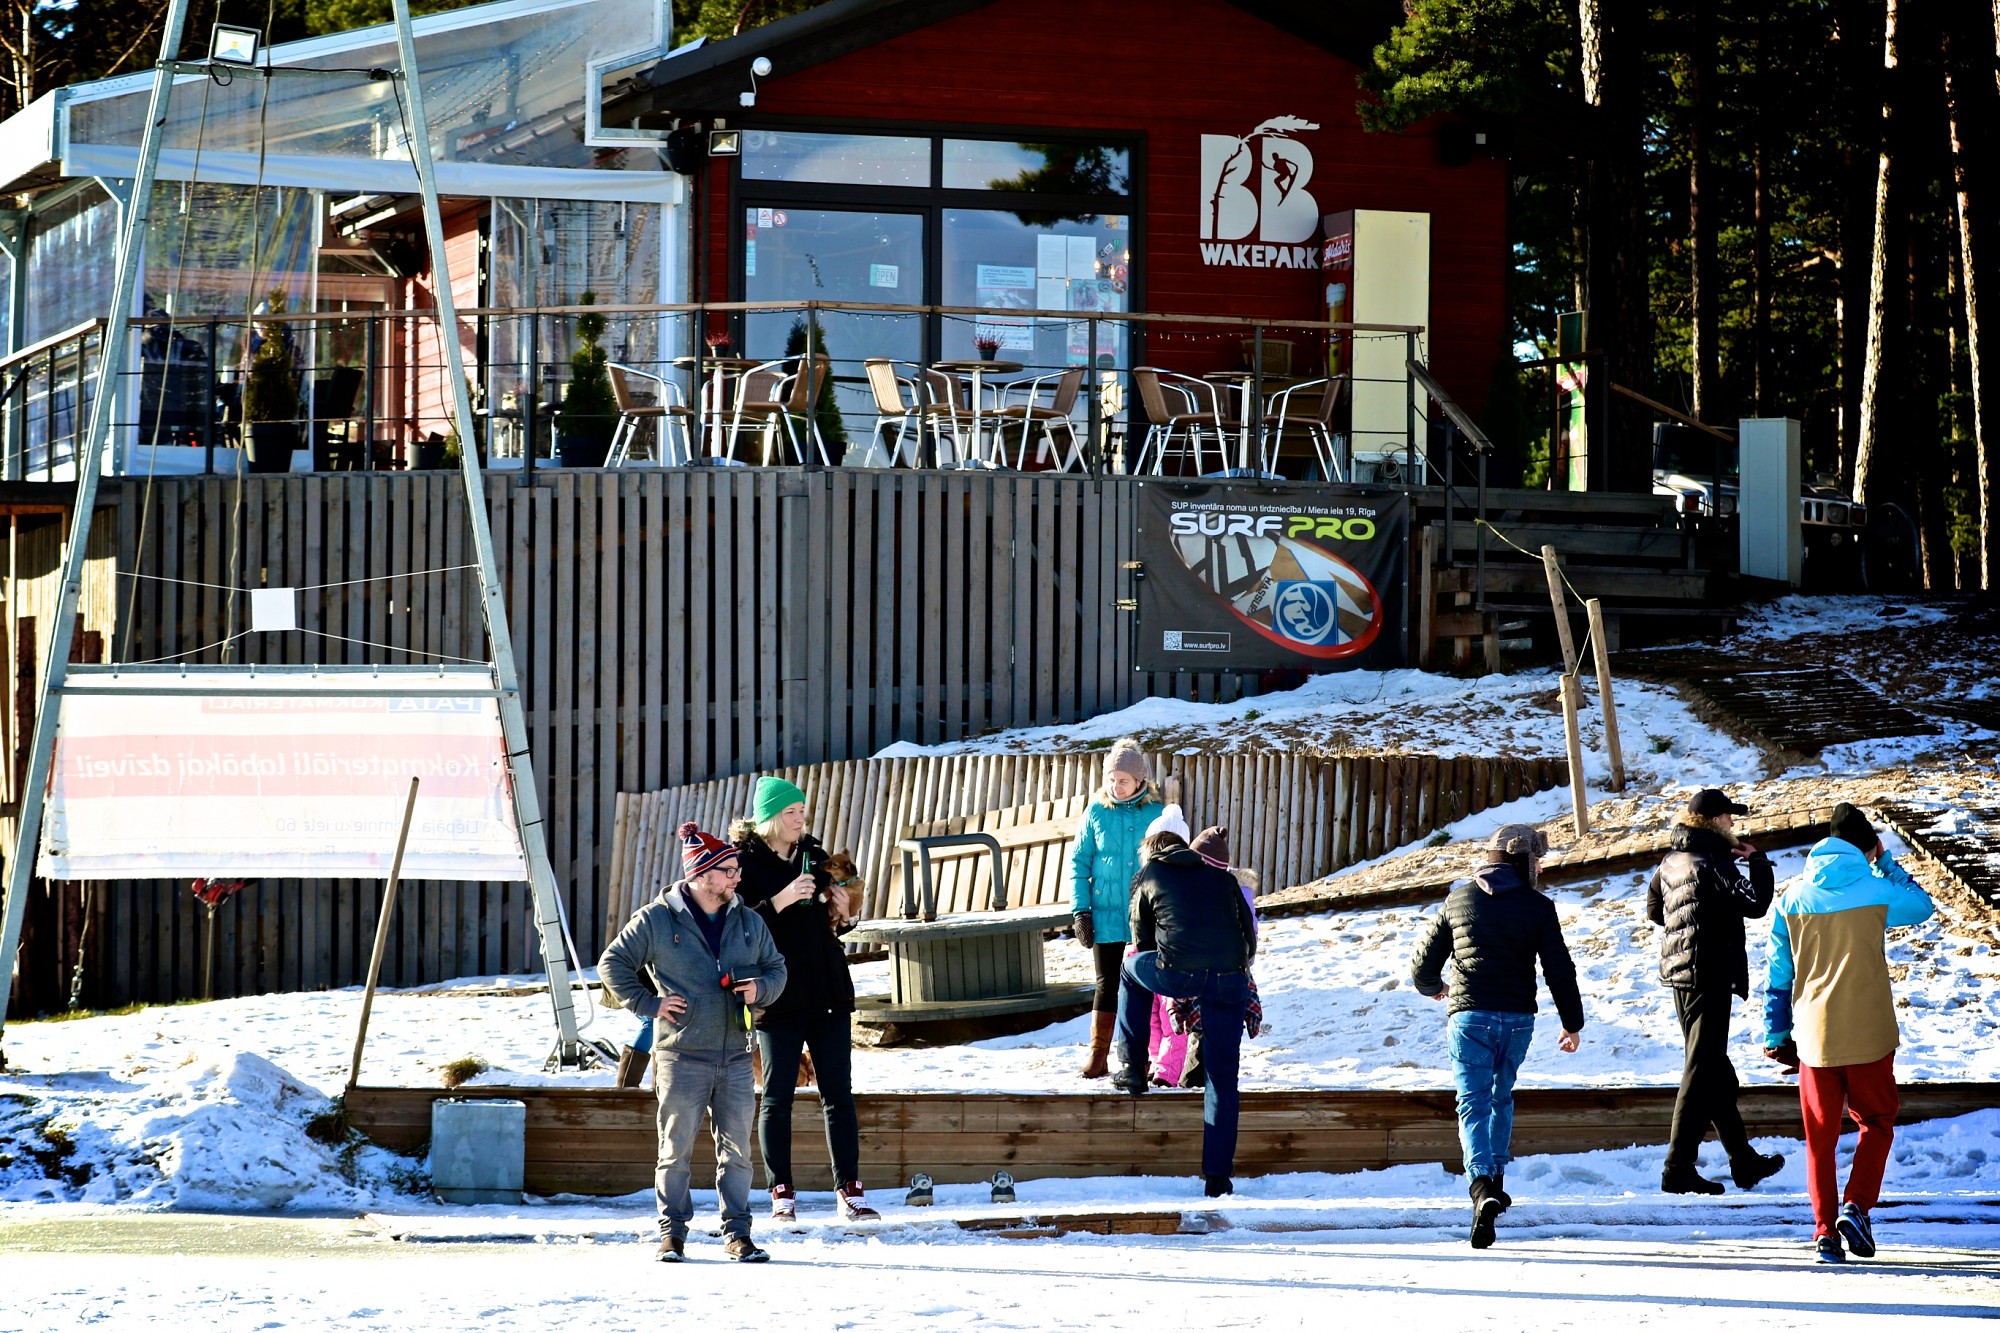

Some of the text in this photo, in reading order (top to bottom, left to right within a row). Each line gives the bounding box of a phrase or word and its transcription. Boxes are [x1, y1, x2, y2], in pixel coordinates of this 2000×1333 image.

[1200, 242, 1320, 270] WAKEPARK
[1171, 501, 1188, 510] SUP
[1190, 502, 1225, 511] inventāra
[1259, 504, 1302, 513] tirdzniecība
[1307, 505, 1329, 515] Miera
[1330, 506, 1344, 515] iela
[1345, 507, 1357, 516] 19,
[1358, 507, 1376, 517] Rīga
[1170, 512, 1376, 540] SURF PRO
[1183, 642, 1227, 650] www.surfpro.lv
